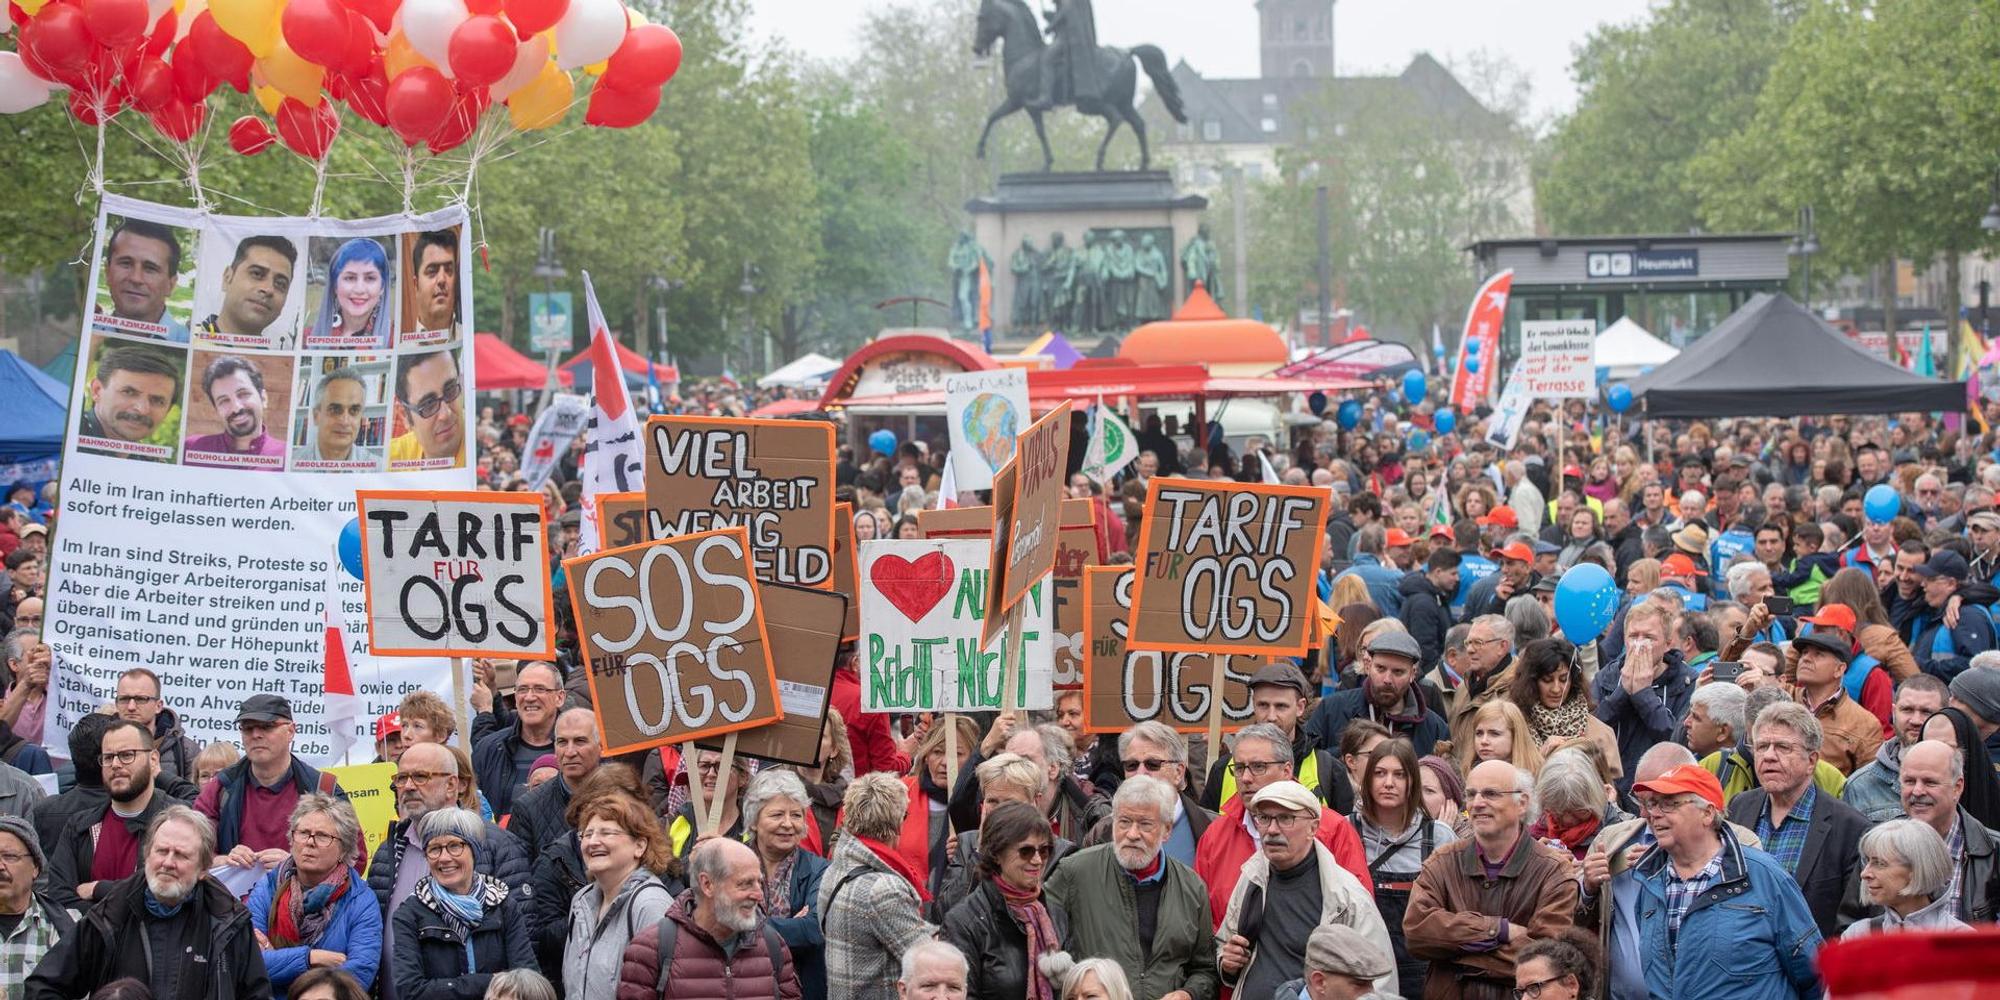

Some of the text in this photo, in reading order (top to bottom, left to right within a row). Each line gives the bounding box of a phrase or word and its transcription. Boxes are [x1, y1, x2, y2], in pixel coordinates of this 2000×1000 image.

[1638, 257, 1694, 270] Heumarkt
[94, 315, 118, 326] JAFAR
[1527, 378, 1585, 392] Terrasse
[78, 437, 166, 455] MAHMOOD BEHESHTI
[187, 452, 280, 465] ROUHOLLAH MARDANI
[654, 425, 760, 481] VIEL
[1022, 420, 1059, 498] VIRUS
[69, 478, 356, 512] Alle im Iran inhaftierten Arbeiter un
[712, 477, 818, 510] ARBEIT
[67, 500, 295, 531] sofort freigelassen werden.
[1159, 490, 1315, 556] TARIF
[368, 510, 540, 562] TARIF
[63, 538, 82, 553] Im
[88, 542, 120, 558] Iran
[126, 547, 162, 562] sind
[168, 550, 231, 570] Streiks,
[238, 555, 304, 572] Proteste
[434, 558, 483, 582] FÜR
[752, 546, 831, 585] ELD
[1145, 551, 1184, 580] FÜR
[61, 562, 179, 586] unabhängiger
[58, 579, 99, 596] Aber
[104, 585, 130, 600] die
[135, 588, 204, 606] Arbeiter
[209, 596, 274, 610] streiken
[280, 598, 310, 612] und
[400, 574, 538, 647] OGS
[583, 535, 755, 653] SOS
[1181, 553, 1296, 642] OGS
[57, 600, 114, 619] überall
[120, 607, 140, 621] im
[147, 610, 189, 626] Land
[195, 615, 226, 628] und
[232, 617, 294, 632] gründen
[55, 620, 190, 646] Organisationen.
[197, 633, 226, 648] Der
[231, 636, 318, 654] Höhepunkt
[1092, 637, 1118, 656] FÜR
[53, 642, 83, 656] seit
[89, 645, 140, 662] einem
[146, 651, 184, 666] Jahr
[189, 657, 238, 670] waren
[244, 658, 268, 671] die
[591, 653, 627, 677] FÜR
[217, 679, 246, 691] von
[252, 678, 285, 692] Haft
[290, 680, 325, 697] Tapp
[360, 681, 395, 694] owie
[398, 682, 422, 694] der
[624, 635, 756, 736] OGS
[1121, 650, 1255, 723] OGS
[58, 695, 239, 731] Unter Protest
[165, 695, 198, 708] von
[201, 695, 242, 711] Ahva
[56, 714, 73, 731] für
[291, 741, 329, 754] Lebe
